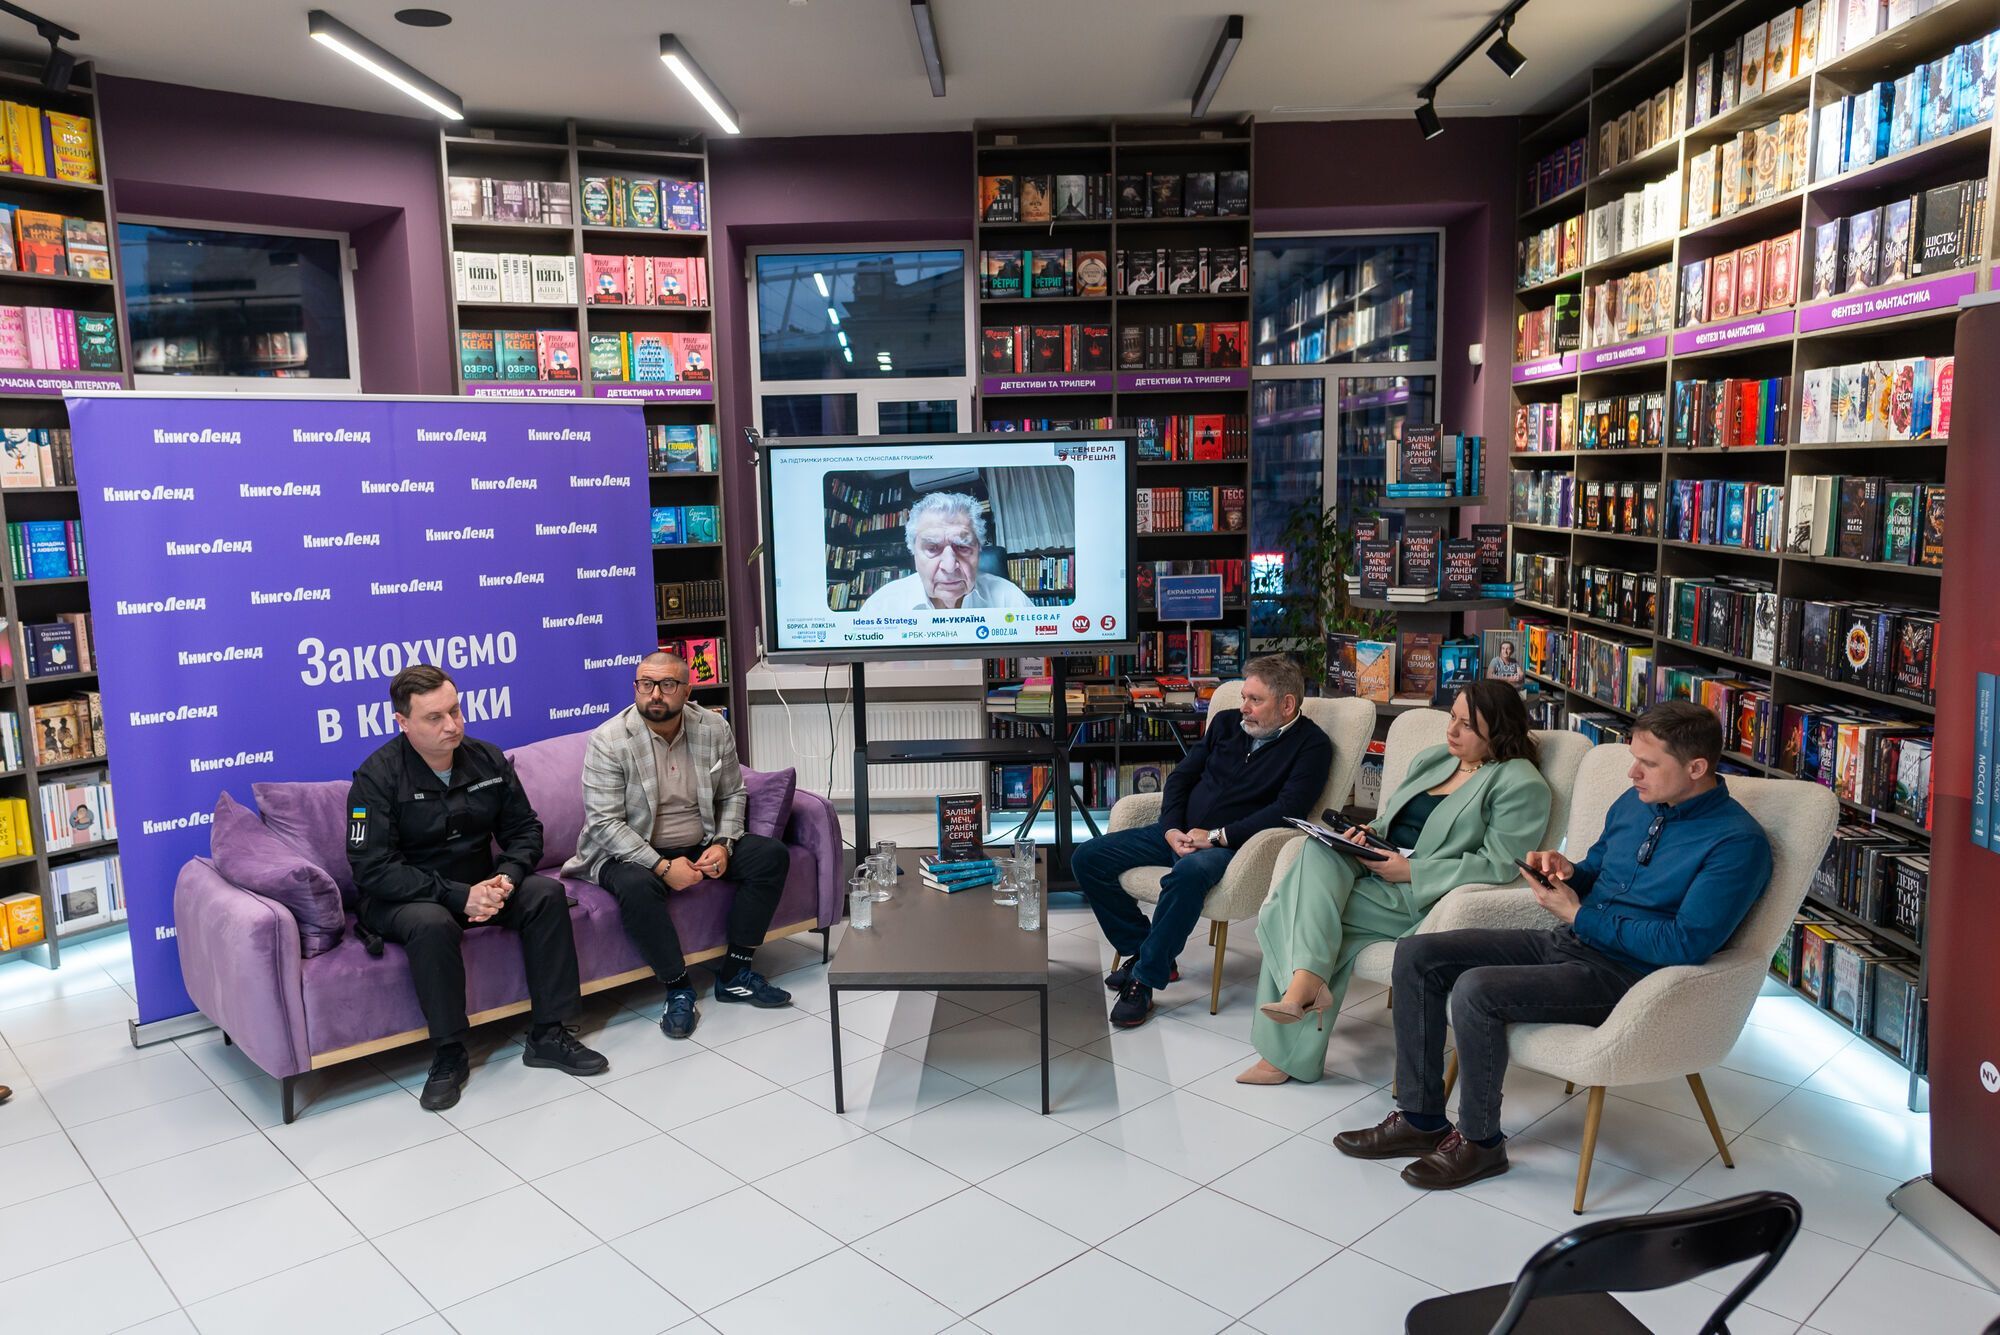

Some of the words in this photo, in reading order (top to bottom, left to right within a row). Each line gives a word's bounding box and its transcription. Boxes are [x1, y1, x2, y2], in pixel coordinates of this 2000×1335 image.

[468, 266, 497, 280] П'ЯТЬ
[536, 268, 564, 282] П'ЯТЬ
[992, 278, 1019, 289] РЕТРИТ
[1034, 276, 1062, 287] РЕТРИТ
[1831, 305, 1863, 319] ФЕНТЕЗІ
[1864, 302, 1874, 313] ТА
[1875, 290, 1931, 312] ФАНТАСТИКА
[462, 332, 493, 340] РЕЙЧЕЛ
[504, 332, 534, 340] РЕЙЧЕЛ
[1695, 332, 1718, 345] ФЕНТЕЗІ
[1719, 330, 1726, 341] ТА
[1726, 322, 1765, 340] ФАНТАСТИКА
[462, 339, 493, 350] КЕЙН
[505, 340, 536, 350] КЕЙН
[464, 364, 494, 373] ОЗЕРО
[507, 364, 536, 373] ОЗЕРО
[36, 378, 73, 389] СВІТОВА
[74, 380, 122, 391] ЛІТЕРАТУРА
[1000, 381, 1047, 390] ДЕТЕКТИВИ
[1060, 380, 1096, 388] ТРИЛЕРИ
[1135, 377, 1182, 387] ДЕТЕКТИВИ
[1183, 376, 1194, 384] ТА
[1194, 376, 1231, 384] ТРИЛЕРИ
[474, 388, 524, 397] ДЕТЕКТИВИ
[526, 388, 537, 396] ТА
[538, 388, 576, 397] ТРИЛЕРИ
[606, 388, 654, 398] ДЕТЕКТИВИ
[666, 388, 702, 396] ТРИЛЕРИ
[154, 428, 241, 444] КнигоЛенд
[293, 428, 371, 444] КнигоЛенд
[417, 428, 487, 442] КнигоЛенд
[528, 428, 591, 442] КнигоЛенд
[1407, 435, 1436, 443] ЗАЛІЗНІ
[1072, 446, 1114, 454] ГЕНЕРАЛ
[1070, 454, 1116, 462] ЧЕРЕШНЯ
[362, 479, 434, 494] КнигоЛенд
[471, 476, 537, 490] КнигоЛенд
[570, 474, 630, 488] КнигоЛенд
[104, 486, 194, 502] КнигоЛенд
[240, 482, 321, 497] КнигоЛенд
[1187, 490, 1210, 500] ТЕСС
[1222, 490, 1244, 500] ТЕСС
[426, 526, 494, 542] КнигоЛенд
[536, 522, 598, 536] КнигоЛенд
[166, 538, 252, 556] КнигоЛенд
[304, 532, 380, 548] КнигоЛенд
[1408, 558, 1430, 566] СЕРЦЯ
[1446, 552, 1476, 560] ЗАЛІЗНІ
[480, 572, 544, 586] КнигоЛенд
[577, 565, 636, 580] КнигоЛенд
[1368, 572, 1388, 580] СЕРЦЯ
[1448, 574, 1472, 582] СЕРЦЯ
[371, 579, 443, 596] КнигоЛенд
[1166, 588, 1217, 596] ЕКРАНІЗОВАНІ
[251, 588, 330, 604] КнигоЛенд
[117, 597, 206, 615] КнигоЛенд
[542, 613, 603, 628] КнигоЛенд
[852, 618, 874, 626] Ideas
[884, 618, 918, 626] Strategy
[932, 614, 986, 624] МИ-УКРАЇНА
[1016, 614, 1061, 622] TELEGRAF
[992, 628, 1018, 636] OBOZ.UA
[178, 646, 263, 666] КнигоЛенд
[298, 631, 517, 686] Закохуємо
[584, 654, 643, 670] КнигоЛенд
[130, 706, 218, 726] КнигоЛенд
[317, 708, 342, 744] в
[357, 686, 512, 738] кнки
[550, 702, 610, 720] КнигоЛенд
[190, 750, 274, 772] КнигоЛенд
[1976, 754, 1987, 806] МОССАД
[945, 808, 976, 816] ЗАЛІЗНІ
[143, 812, 215, 834] КнигоЛе
[950, 816, 972, 824] МЕЧІ,
[949, 832, 974, 840] СЕРЦЯ
[1896, 888, 1919, 912] ТИЙ
[1982, 1068, 1998, 1084] NV
